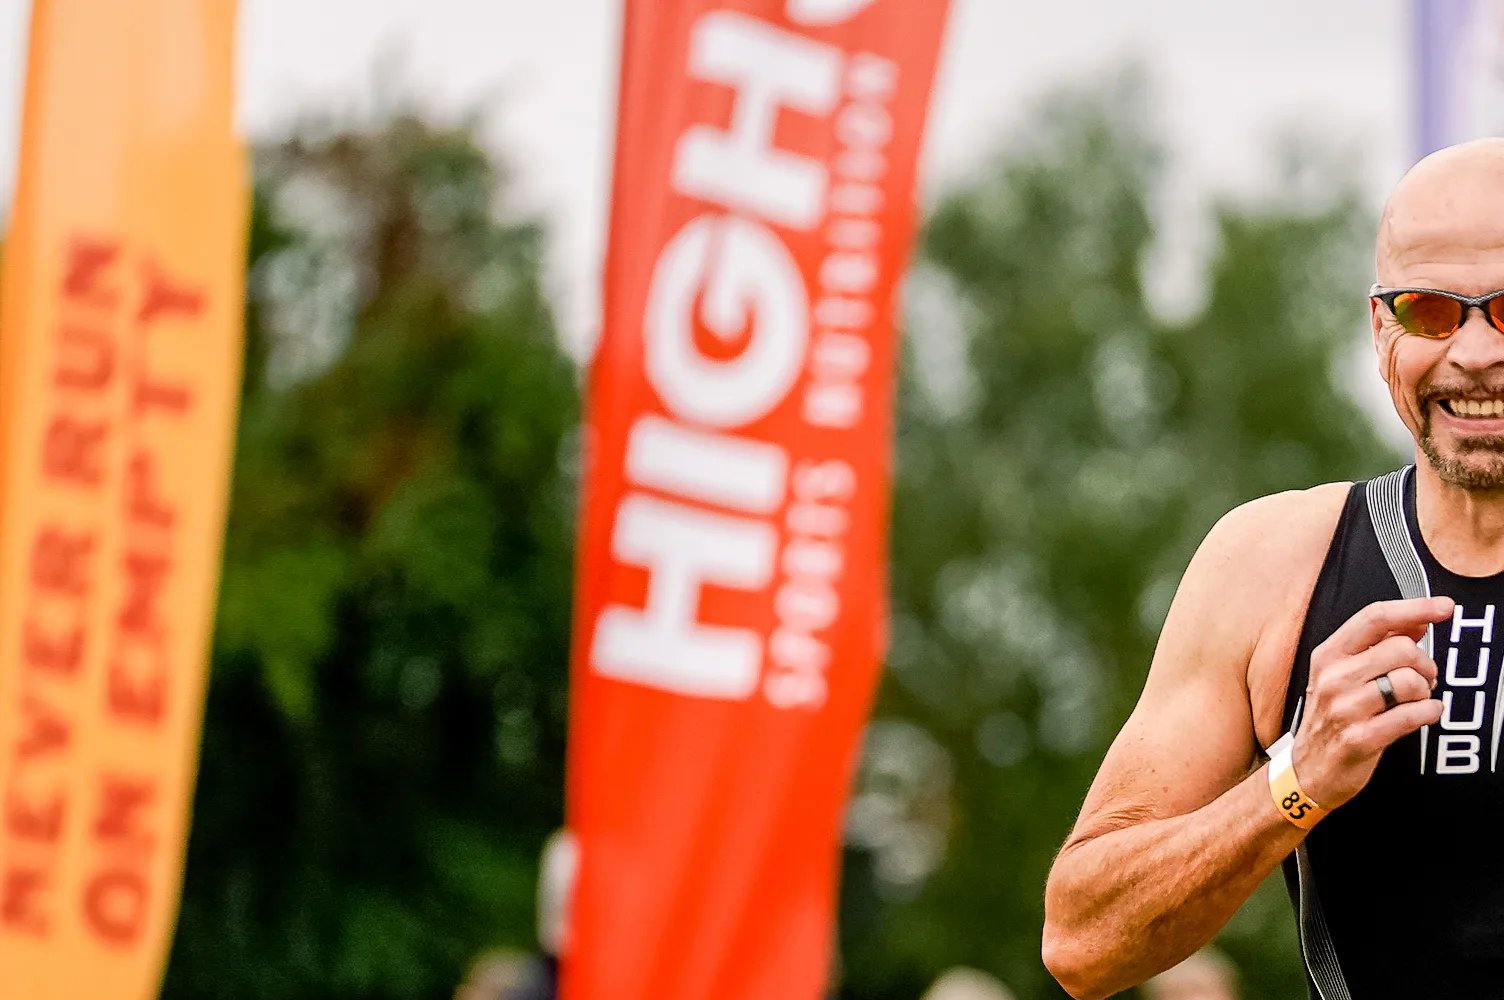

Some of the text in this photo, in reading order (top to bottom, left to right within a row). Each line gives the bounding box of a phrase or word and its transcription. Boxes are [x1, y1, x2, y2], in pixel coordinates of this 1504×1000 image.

[0, 238, 121, 938] NEVER RUN
[80, 254, 207, 948] ON EMPTY
[589, 0, 872, 700] HIGH
[1436, 604, 1496, 775] HUUB
[1281, 791, 1312, 820] 85
